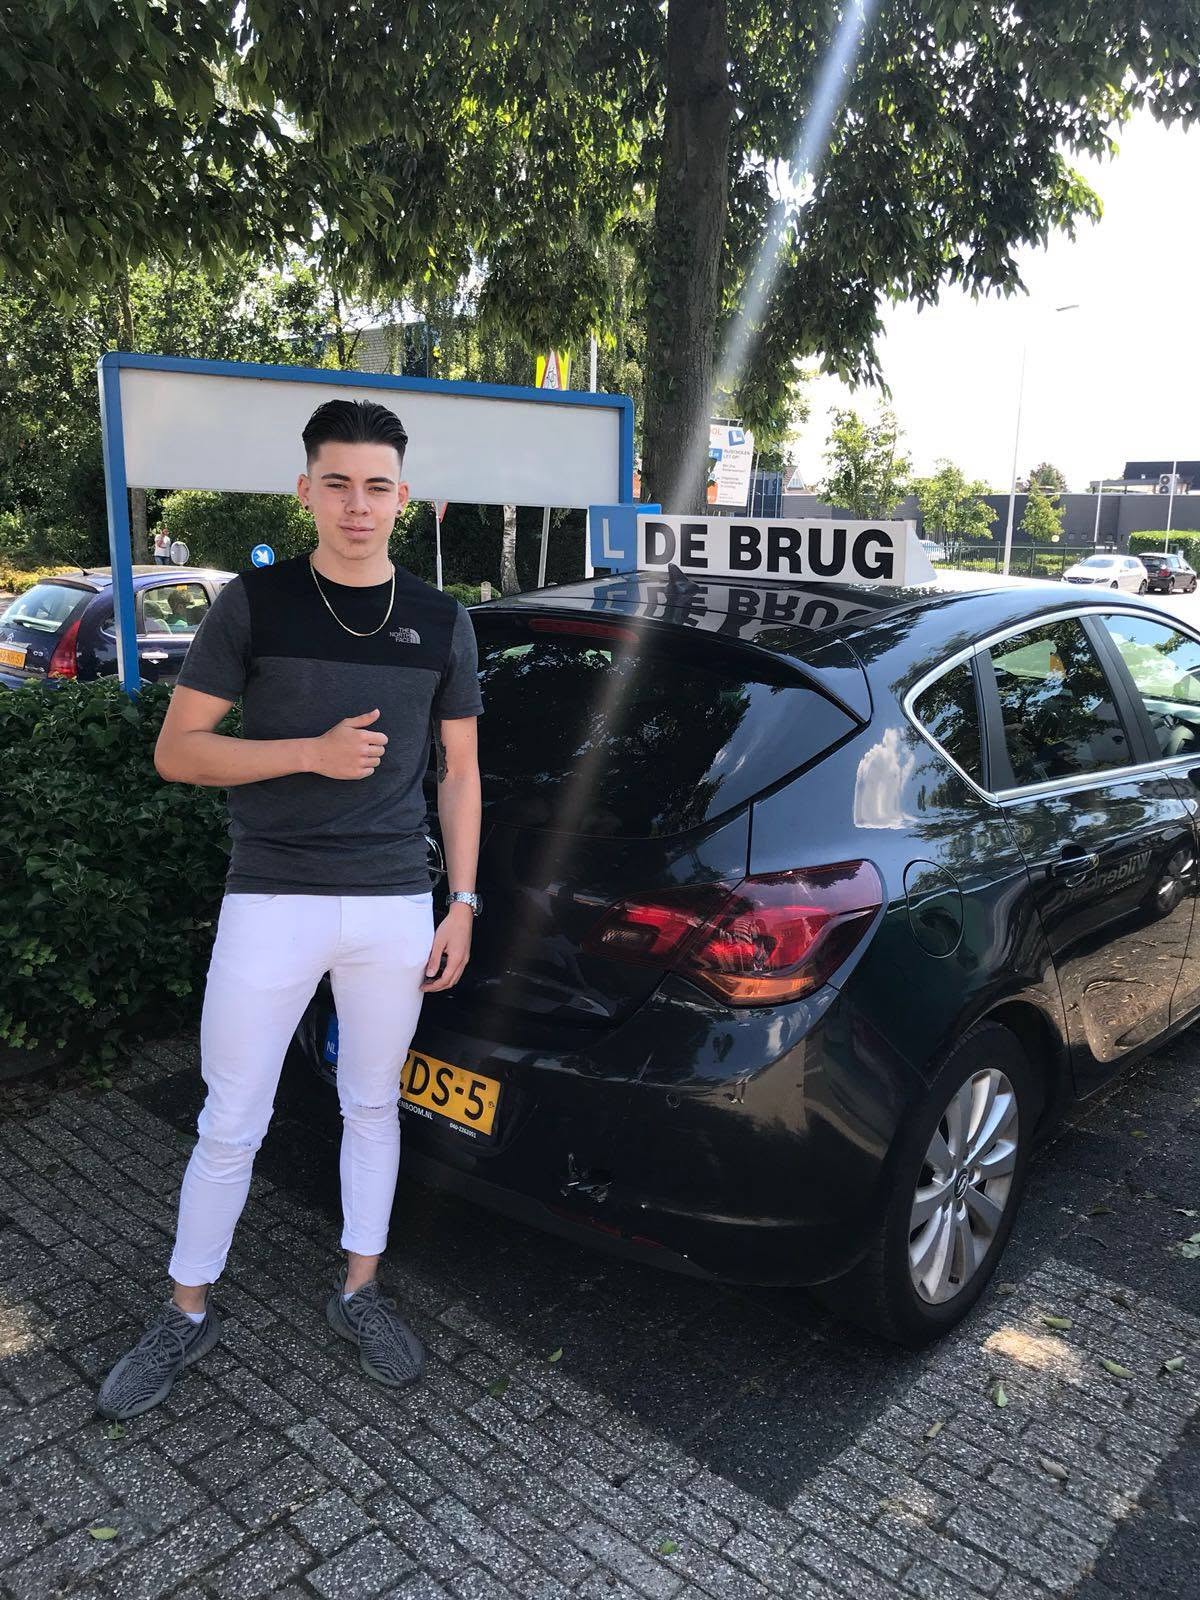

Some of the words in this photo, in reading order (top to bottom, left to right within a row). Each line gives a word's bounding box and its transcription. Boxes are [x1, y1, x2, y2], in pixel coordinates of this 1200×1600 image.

[602, 518, 625, 559] L
[645, 521, 709, 569] DE
[729, 525, 894, 580] BRUG
[390, 631, 411, 640] NORTH
[399, 626, 410, 634] THE
[395, 636, 411, 644] FACE
[326, 1040, 337, 1055] NL
